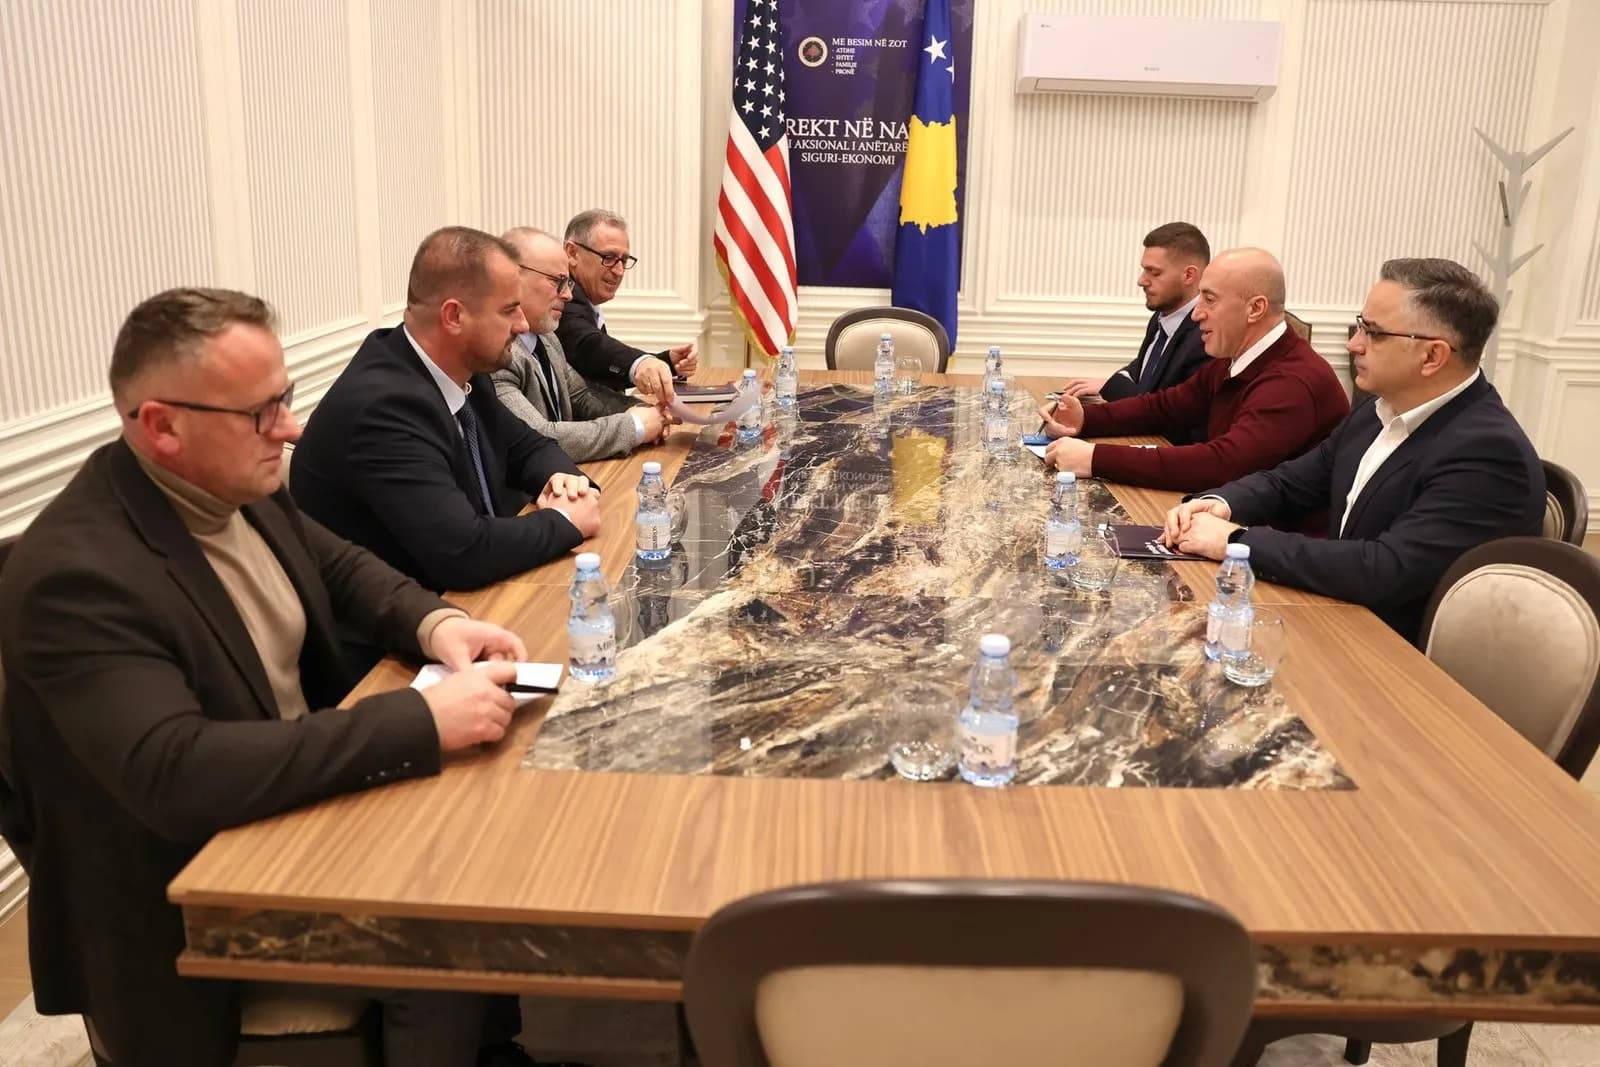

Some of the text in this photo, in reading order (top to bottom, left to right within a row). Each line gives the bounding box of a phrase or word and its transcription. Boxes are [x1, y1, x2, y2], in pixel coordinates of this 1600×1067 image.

[832, 37, 908, 48] ME BESIM NË ZOT
[843, 117, 874, 139] NË
[879, 121, 911, 140] NA
[794, 139, 850, 151] AKSIONAL
[852, 141, 856, 151] I
[801, 152, 896, 165] SIGURI-EKONOMI
